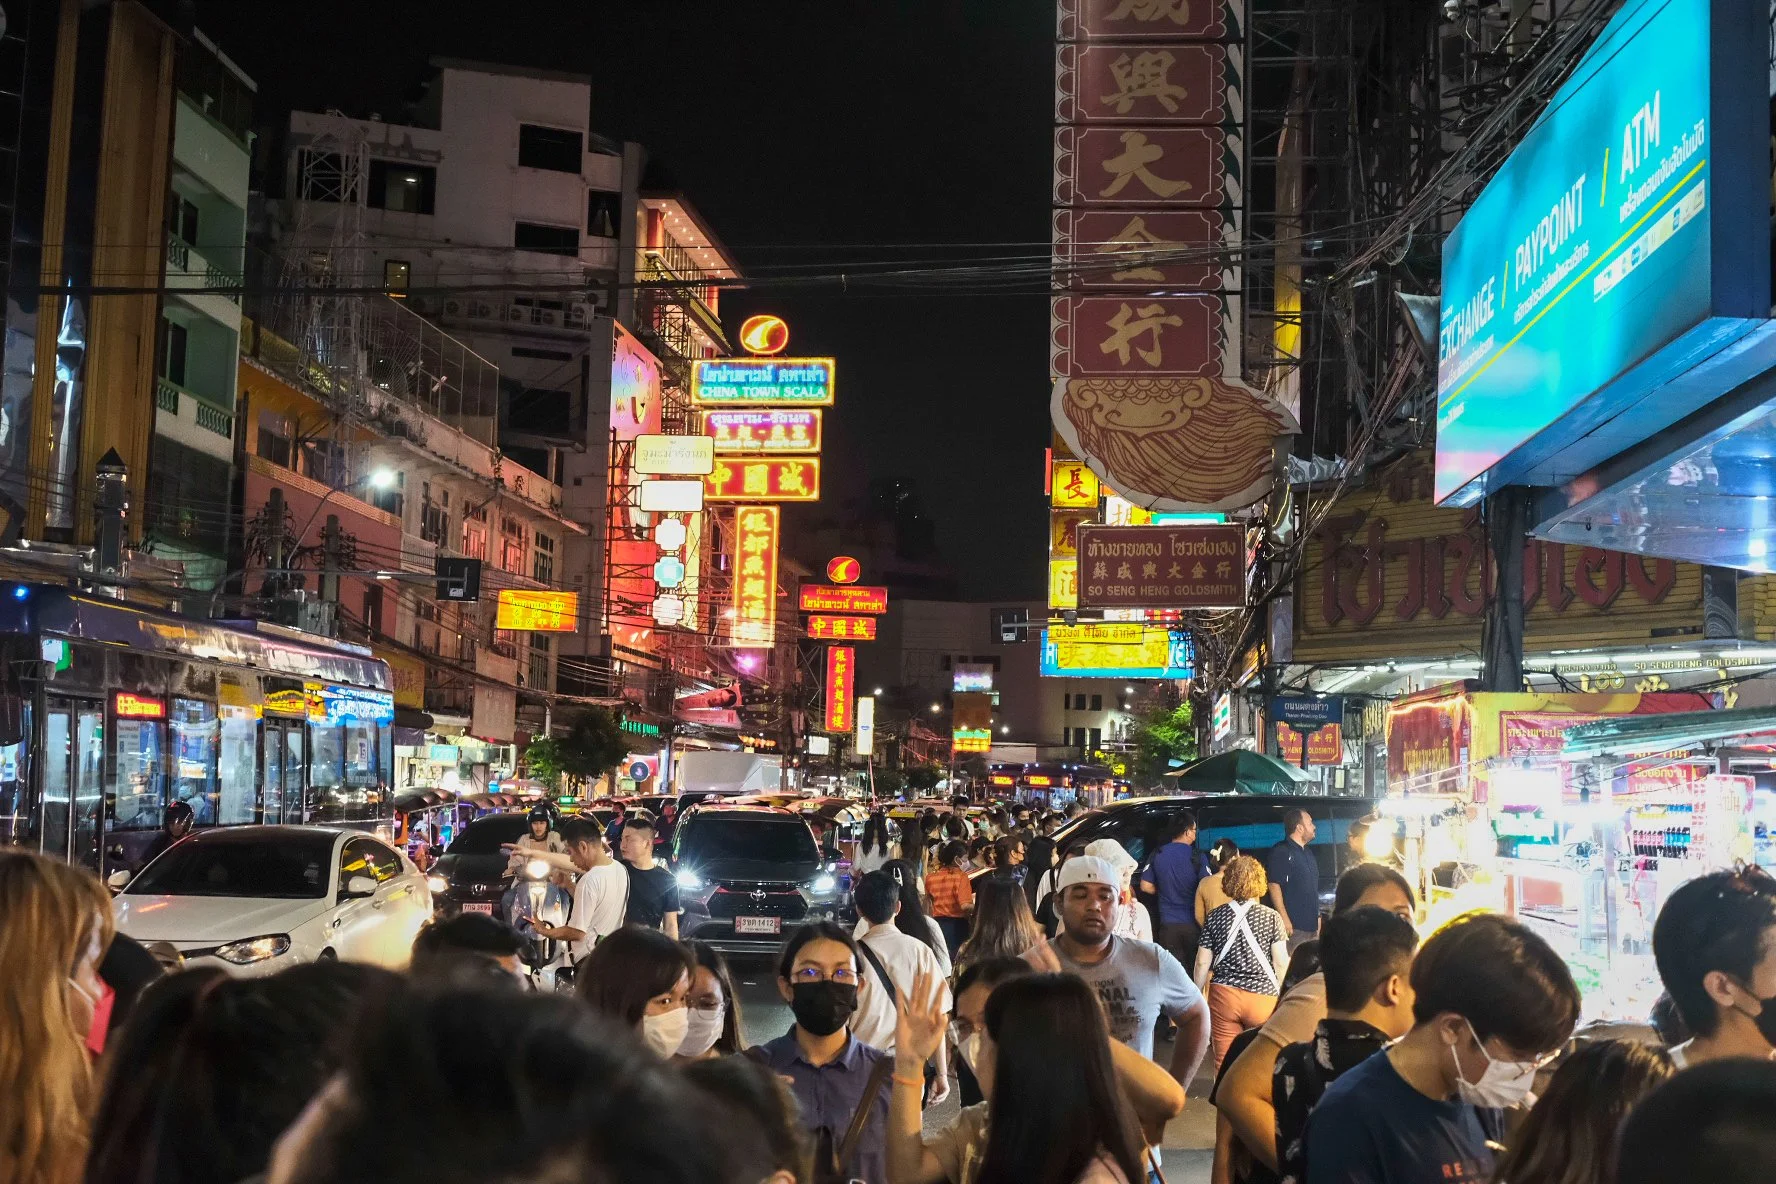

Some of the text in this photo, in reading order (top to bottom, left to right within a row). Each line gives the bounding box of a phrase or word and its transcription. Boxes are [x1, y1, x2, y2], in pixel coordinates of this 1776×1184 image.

[1100, 0, 1192, 367] 興大金行
[1440, 275, 1495, 367] EXCHANGE
[1515, 173, 1586, 292] PAYPOINT
[1620, 89, 1660, 184] ATM
[700, 386, 825, 398] CHINA TOWN SCALA
[707, 461, 807, 496] 中國城
[1087, 533, 1236, 557] ห้างขายทอง โซวเซ่งเฮง
[1088, 584, 1236, 597] SO SENG HENG GOLDSMITH
[812, 617, 870, 638] 中國城
